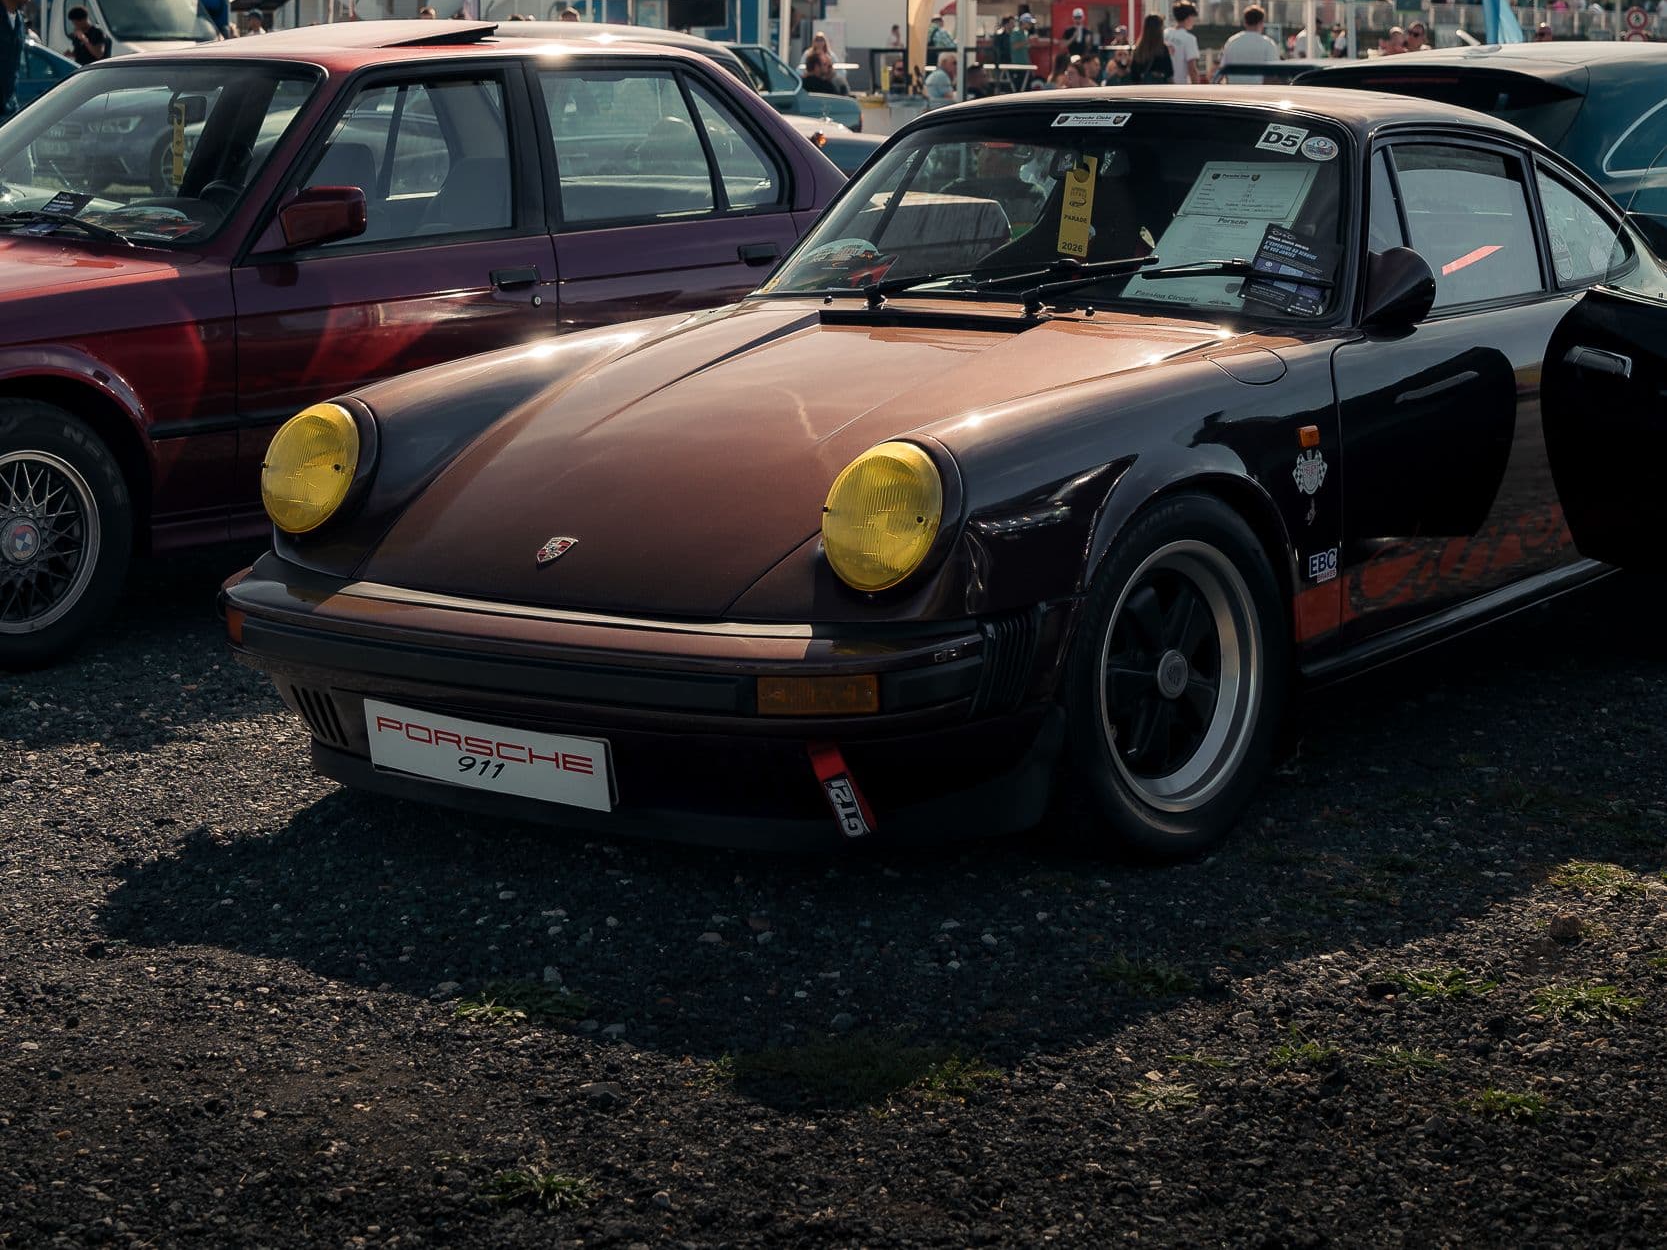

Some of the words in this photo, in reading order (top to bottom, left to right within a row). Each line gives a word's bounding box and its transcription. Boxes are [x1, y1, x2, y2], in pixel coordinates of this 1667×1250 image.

[1262, 131, 1301, 148] D5
[1063, 213, 1088, 223] PARADE
[1310, 550, 1337, 576] EBC
[376, 716, 594, 775] PORSCHE
[458, 756, 506, 779] 911
